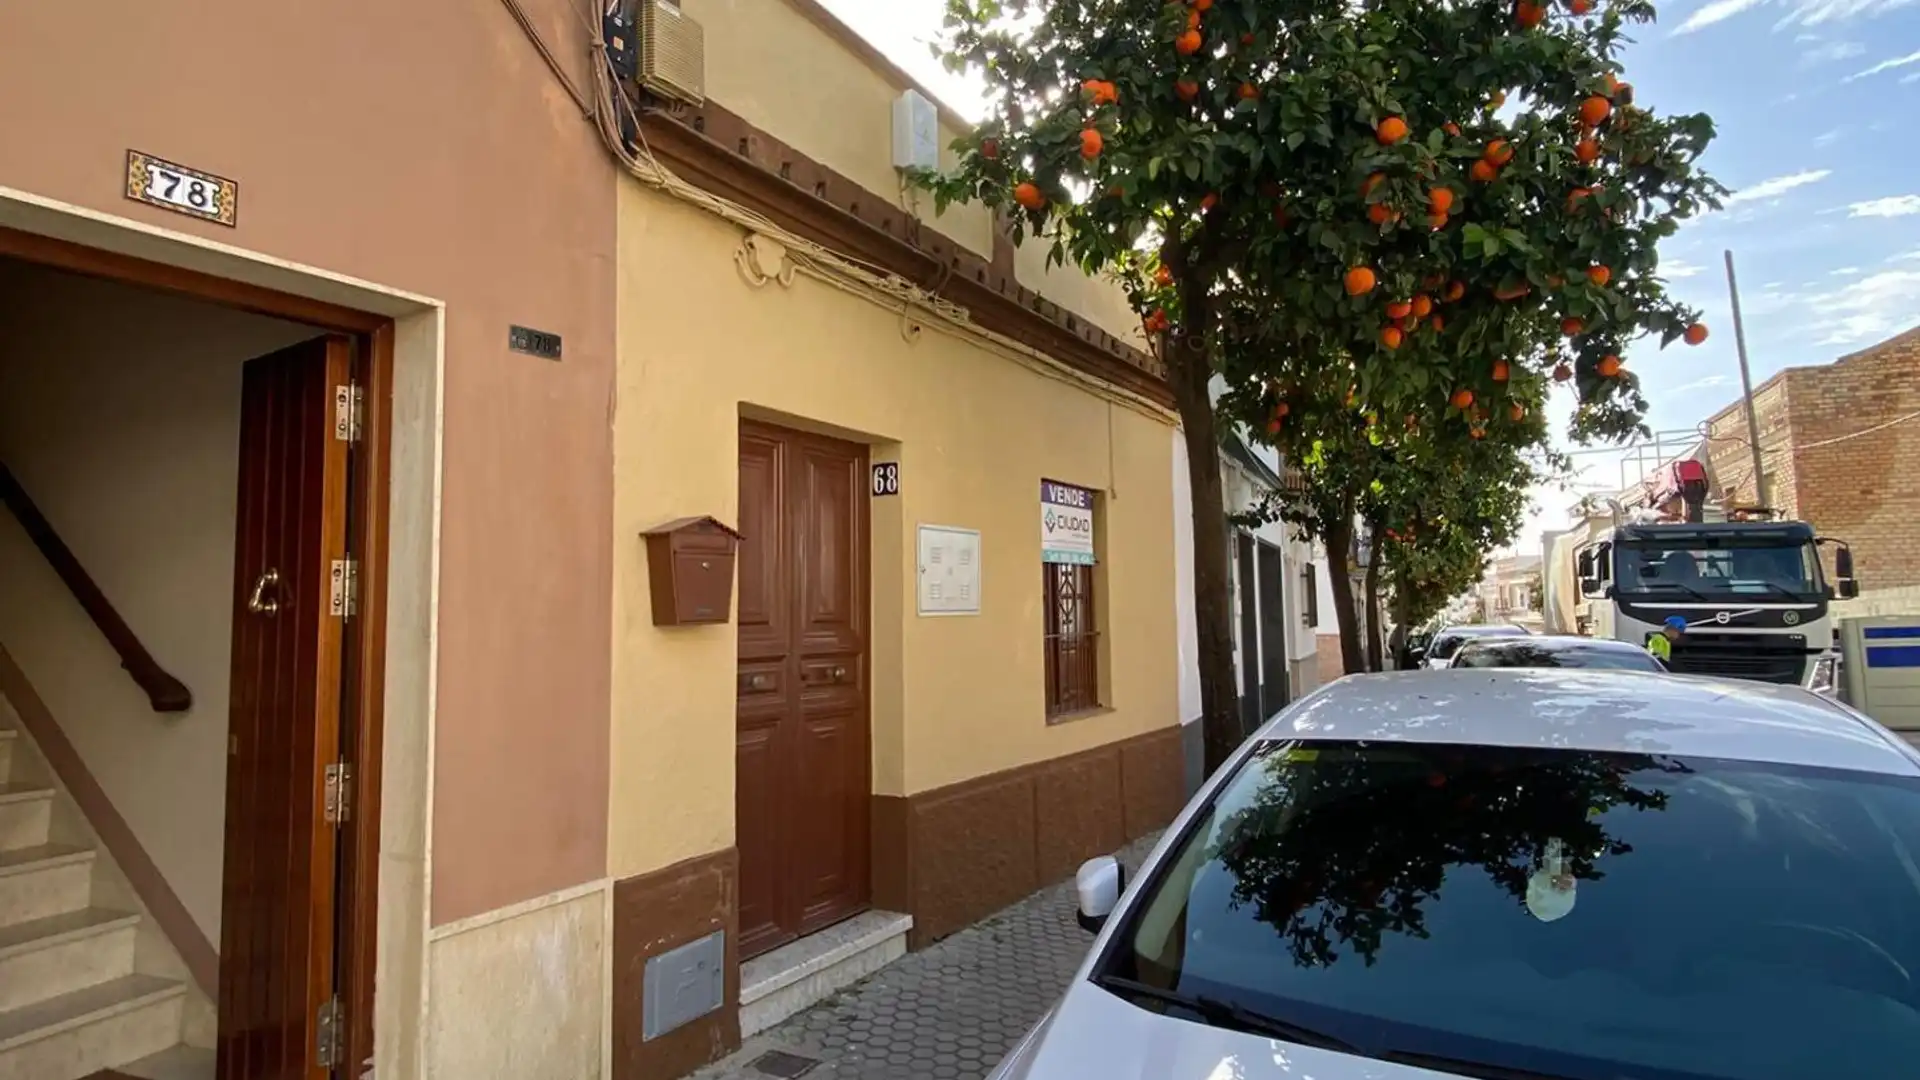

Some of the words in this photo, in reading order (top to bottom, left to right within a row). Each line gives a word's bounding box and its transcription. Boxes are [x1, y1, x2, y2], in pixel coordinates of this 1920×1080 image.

[159, 170, 207, 208] 78
[873, 465, 897, 494] 68
[1048, 484, 1085, 507] VENDE
[1057, 515, 1090, 532] CIUDAD
